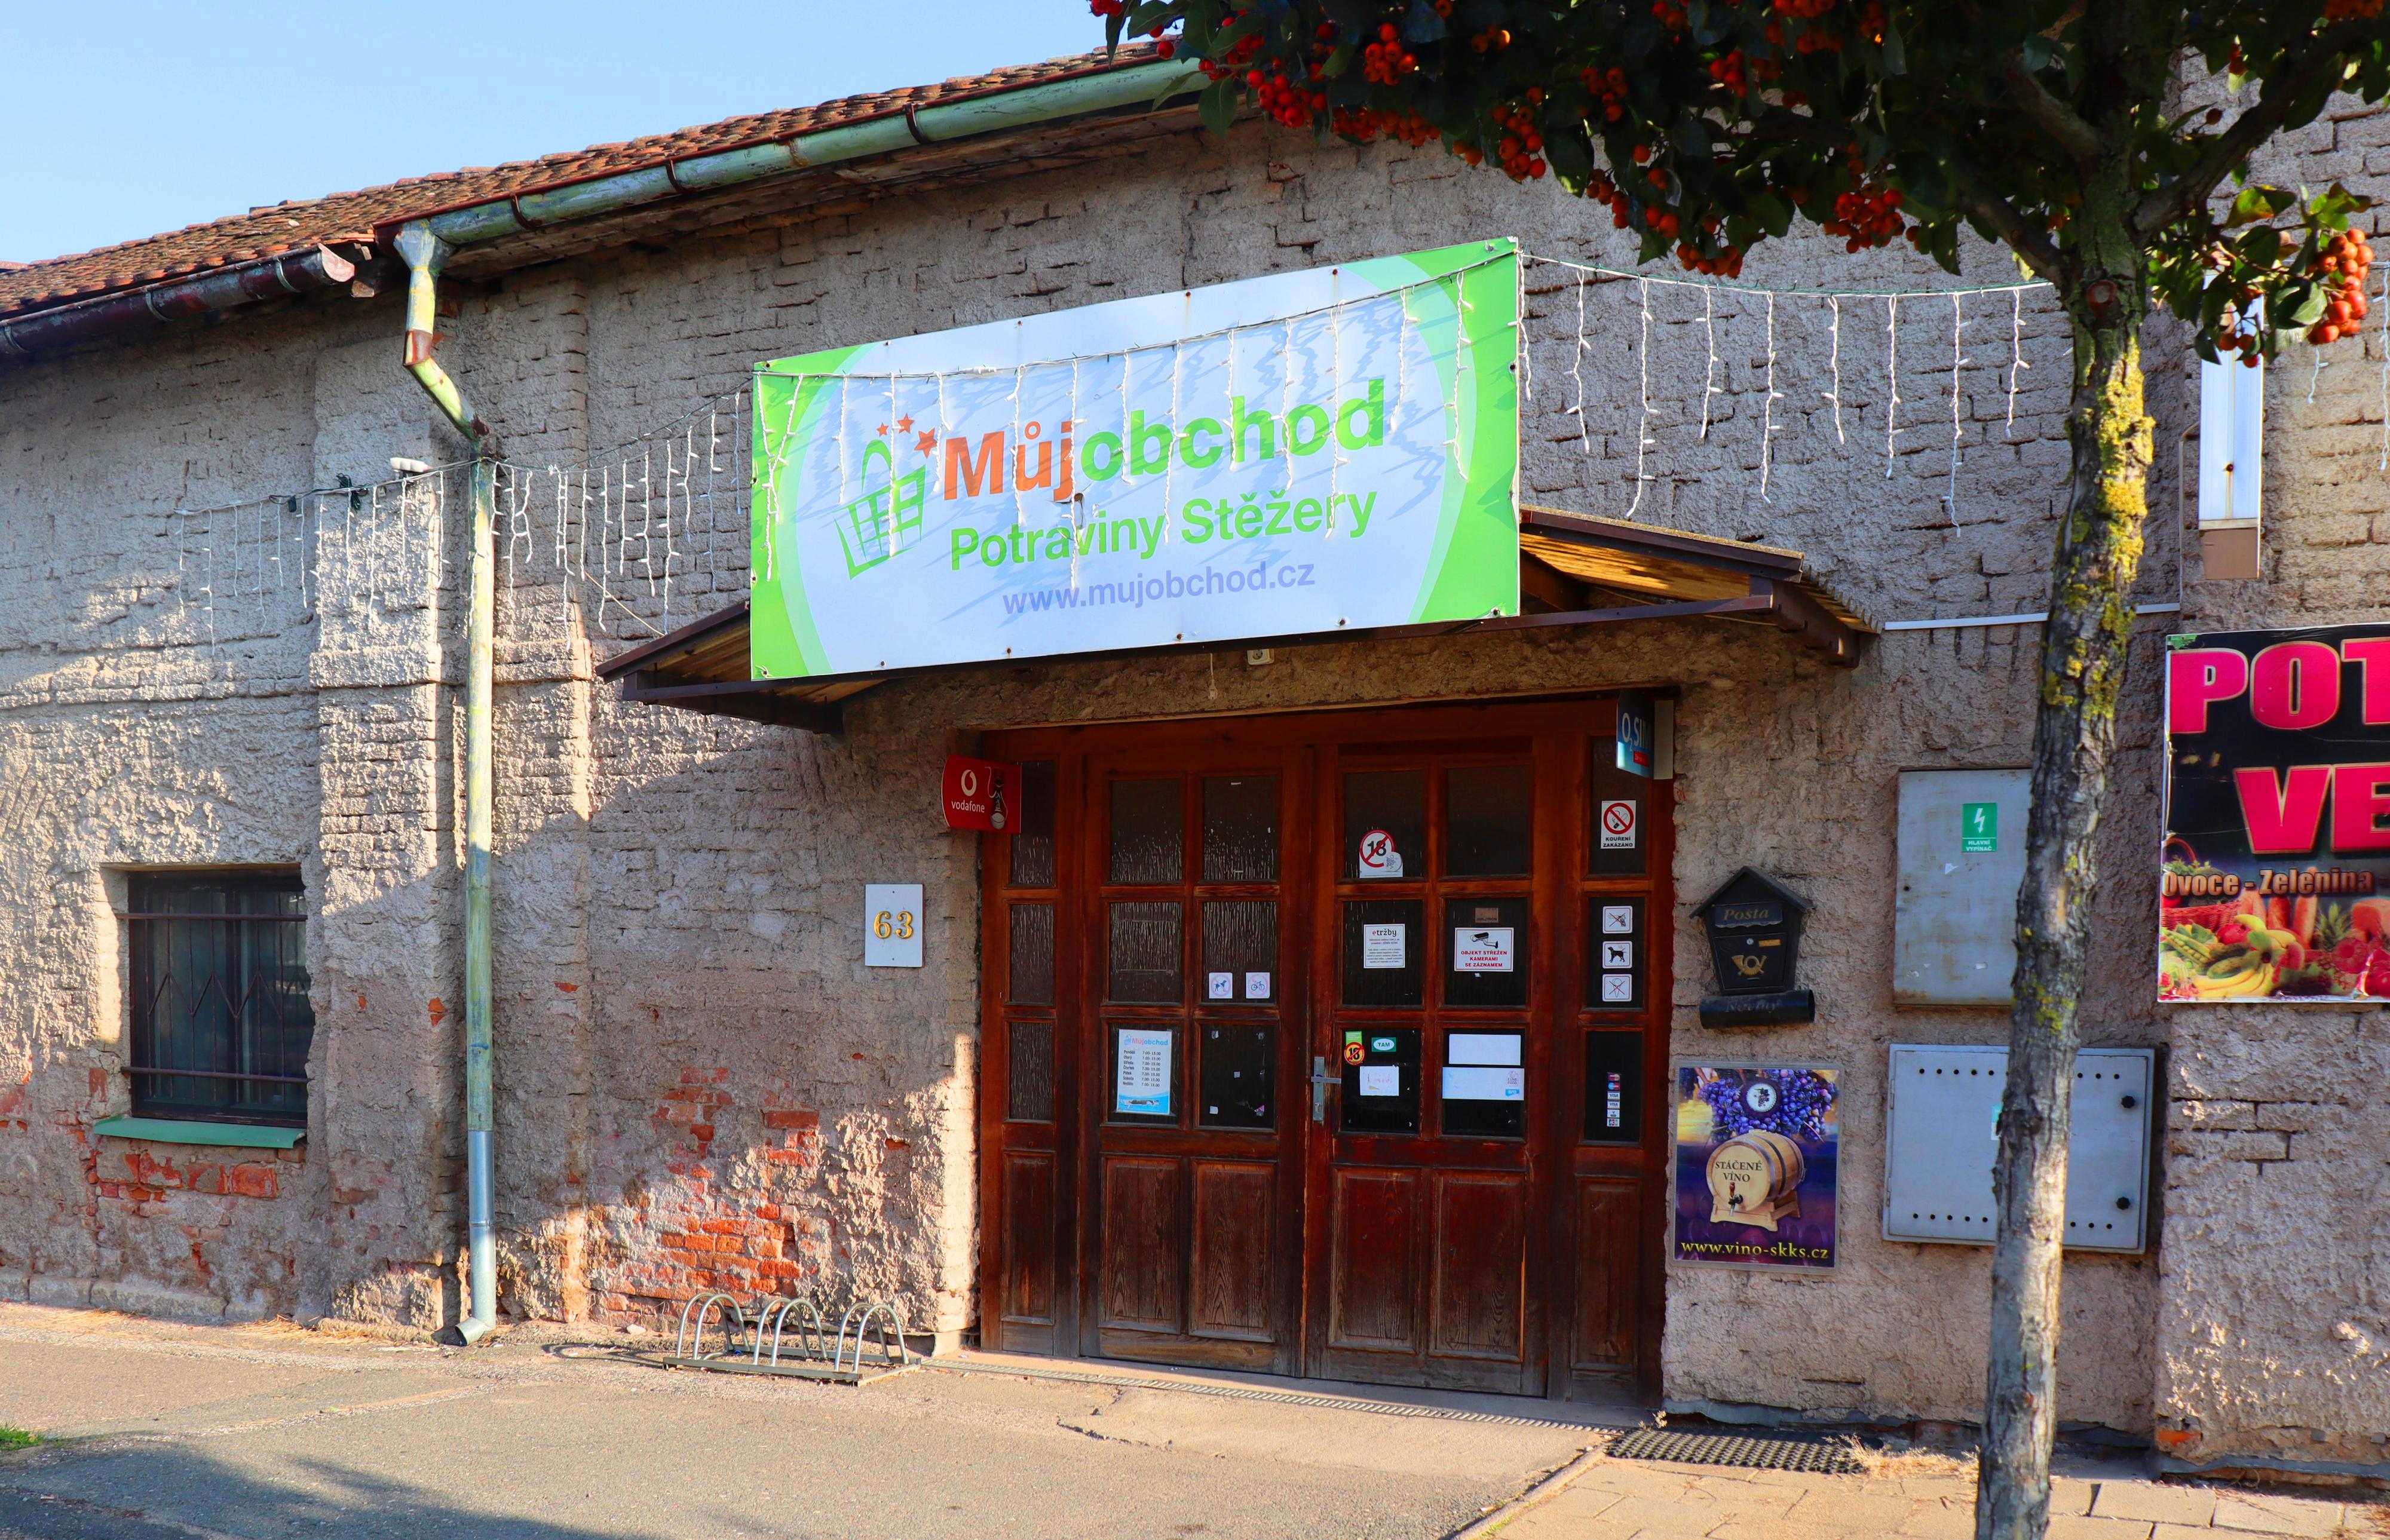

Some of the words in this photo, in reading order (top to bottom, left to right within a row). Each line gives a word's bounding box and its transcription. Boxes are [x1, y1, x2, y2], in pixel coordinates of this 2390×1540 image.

[944, 378, 1384, 502] Můjobchod
[951, 511, 1165, 570] Potraviny
[1181, 488, 1377, 544] Stěžery
[1003, 562, 1314, 615] www.mujobchod.cz
[951, 799, 985, 813] vodafone
[1367, 840, 1387, 856] 18
[2162, 871, 2239, 896] Ovoce
[2260, 867, 2373, 895] Zelenina
[1723, 908, 1769, 921] Pošta
[874, 911, 914, 939] 63
[1372, 928, 1397, 937] etržby
[1715, 1159, 1763, 1171] STÁČENÉ
[1723, 1171, 1751, 1182] VÍNO
[1680, 1241, 1829, 1259] www.vino-skks.cz
